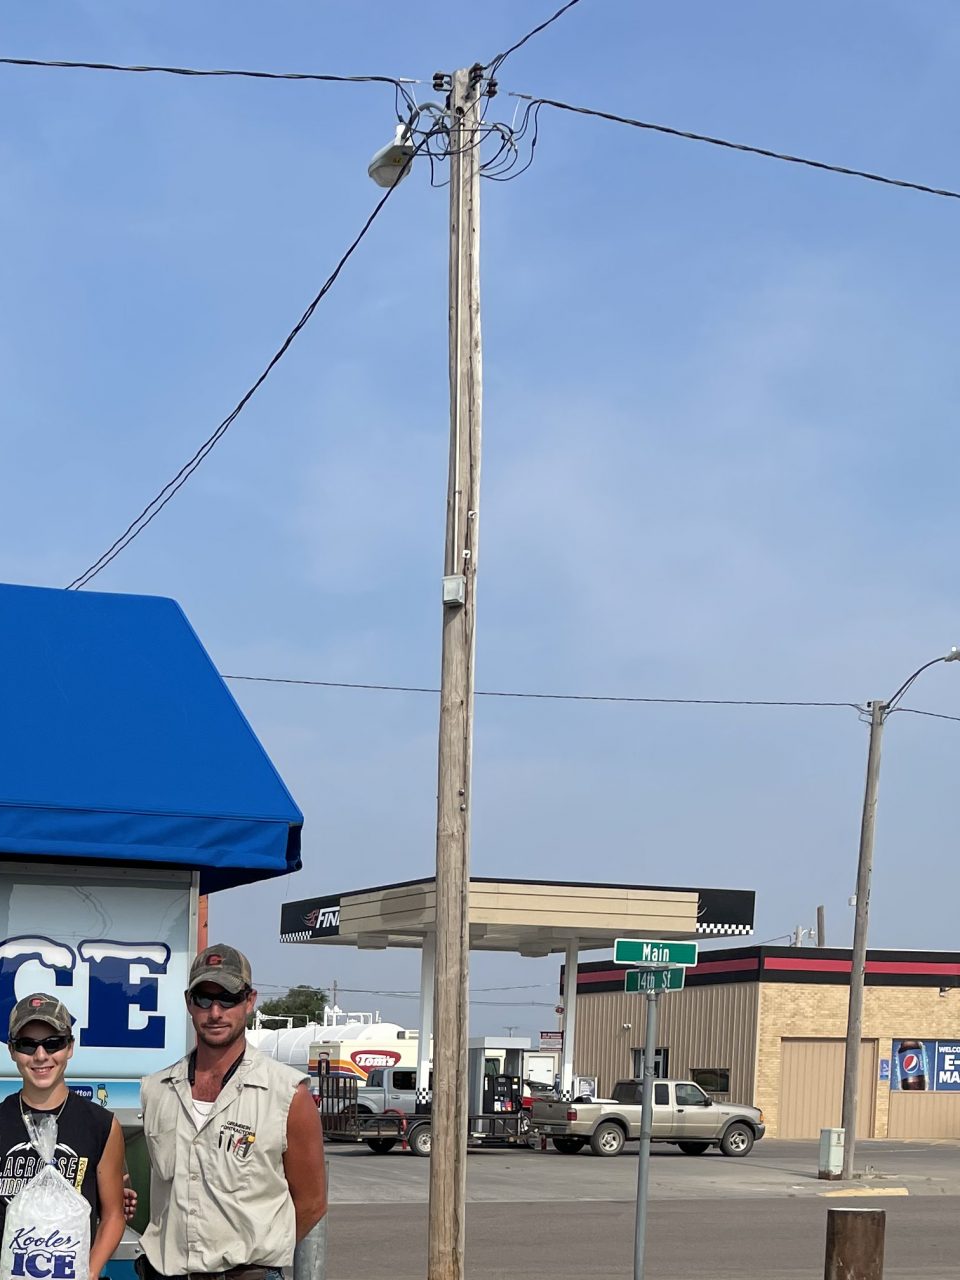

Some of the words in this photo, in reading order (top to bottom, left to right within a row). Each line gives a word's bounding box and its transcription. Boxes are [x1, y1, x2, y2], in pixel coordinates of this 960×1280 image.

[642, 943, 670, 962] Main
[637, 972, 655, 989] 14th
[661, 970, 671, 988] St
[355, 1053, 396, 1067] Tom's
[8, 1226, 81, 1250] Kooler
[10, 1248, 77, 1280] ICE
